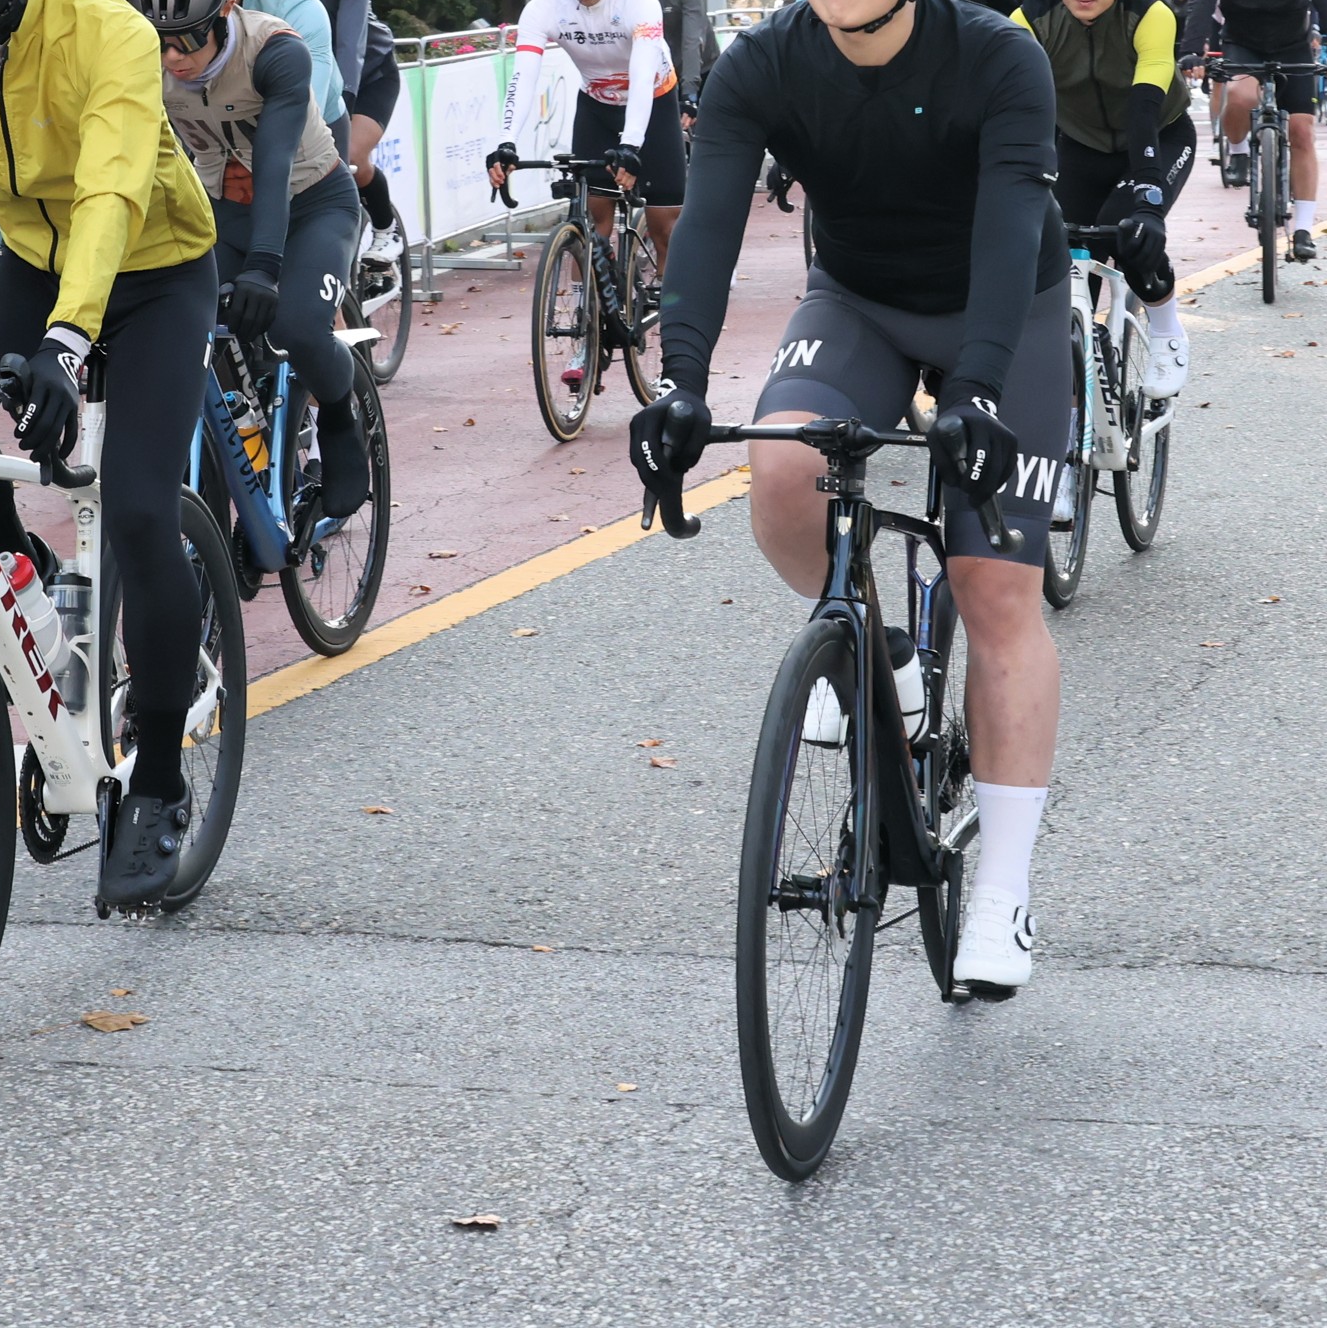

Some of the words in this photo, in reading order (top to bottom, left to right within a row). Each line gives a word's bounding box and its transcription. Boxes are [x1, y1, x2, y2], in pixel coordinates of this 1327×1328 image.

[505, 72, 521, 109] SEJONG
[503, 109, 515, 131] CITY
[766, 338, 823, 380] YN
[17, 403, 37, 433] GIYO
[641, 440, 659, 472] GIYO
[970, 449, 986, 481] GIYO
[997, 452, 1059, 504] YN
